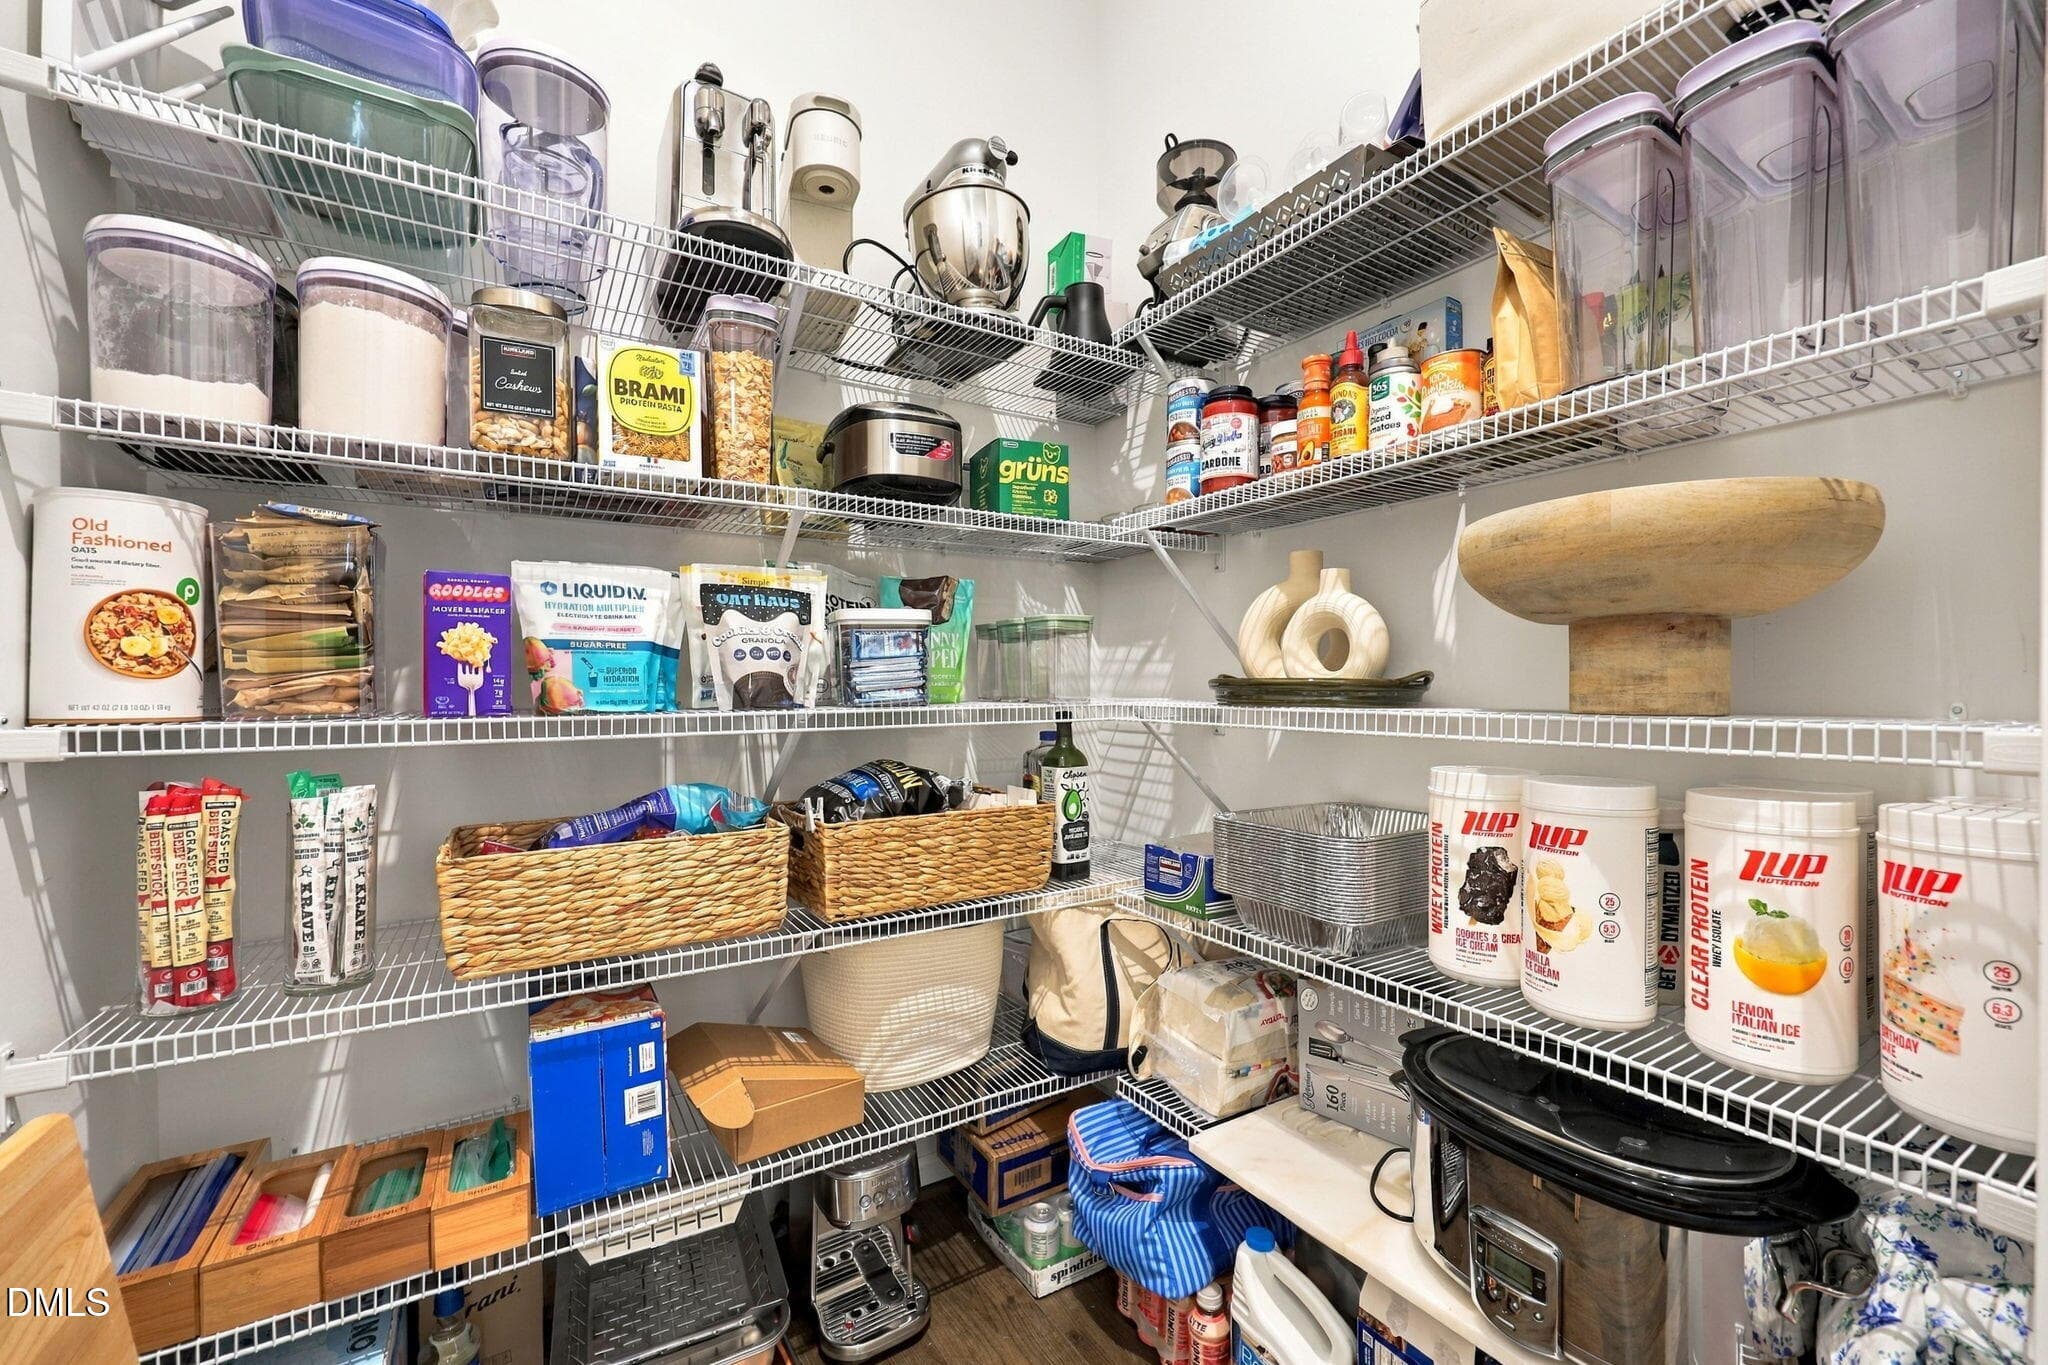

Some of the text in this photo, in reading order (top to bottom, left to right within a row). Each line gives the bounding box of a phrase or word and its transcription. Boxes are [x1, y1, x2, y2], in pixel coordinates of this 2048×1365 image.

[495, 376, 542, 393] Cashews
[614, 378, 685, 405] BRAMI
[1371, 380, 1388, 395] 365
[620, 397, 682, 413] PROTEIN PASTA
[999, 456, 1069, 484] grüns
[72, 517, 108, 532] Old
[71, 546, 97, 554] OATS
[72, 532, 172, 553] Fashioned
[429, 583, 507, 600] GOODLES
[563, 582, 647, 601] LIQUID I.V.
[741, 577, 771, 587] Simple
[544, 601, 645, 613] HYDRATION MULTIPLIER
[715, 593, 751, 606] OAT
[473, 607, 506, 615] SHAKER
[570, 641, 627, 650] SUGAR-FREE
[741, 637, 787, 645] GRANOLA
[603, 675, 639, 683] HYDRATION
[605, 667, 638, 675] SUPERIOR
[1461, 810, 1520, 836] 1UP
[206, 810, 220, 874] BEEF STICK
[218, 810, 232, 873] GRASS-FED
[1528, 821, 1589, 849] 1UP
[1537, 845, 1579, 857] NUTRITION
[149, 831, 163, 897] BEEF STICK
[172, 831, 189, 897] BEEF STICK
[184, 830, 199, 895] GRASS-FED
[1739, 849, 1828, 881] 1UP
[1431, 821, 1443, 935] WHEY PROTEIN
[1756, 876, 1820, 887] NUTRITION
[1882, 860, 1963, 896] 1UP
[1604, 896, 1615, 906] 25
[1660, 871, 1681, 943] DYMATIZED
[1889, 890, 1950, 908] NUTRITION
[300, 881, 315, 943] KRAVE
[354, 882, 366, 941] KRAVE
[1455, 927, 1521, 944] COOKIES & CREA
[1690, 858, 1710, 1011] CLEAR PROTEIN
[1711, 909, 1722, 968] WHEY ISOLATE
[1455, 938, 1499, 953] ICE CREAM
[1525, 948, 1551, 967] VANILLA
[1525, 959, 1560, 982] ICE CREAM
[1993, 966, 2011, 979] 25
[1731, 1000, 1774, 1020] LEMON
[1731, 1012, 1778, 1034] ITALIAN
[1781, 1023, 1801, 1038] ICE
[1325, 1084, 1339, 1112] 160
[1338, 1092, 1347, 1112] Pieces
[464, 1275, 521, 1319] rani.
